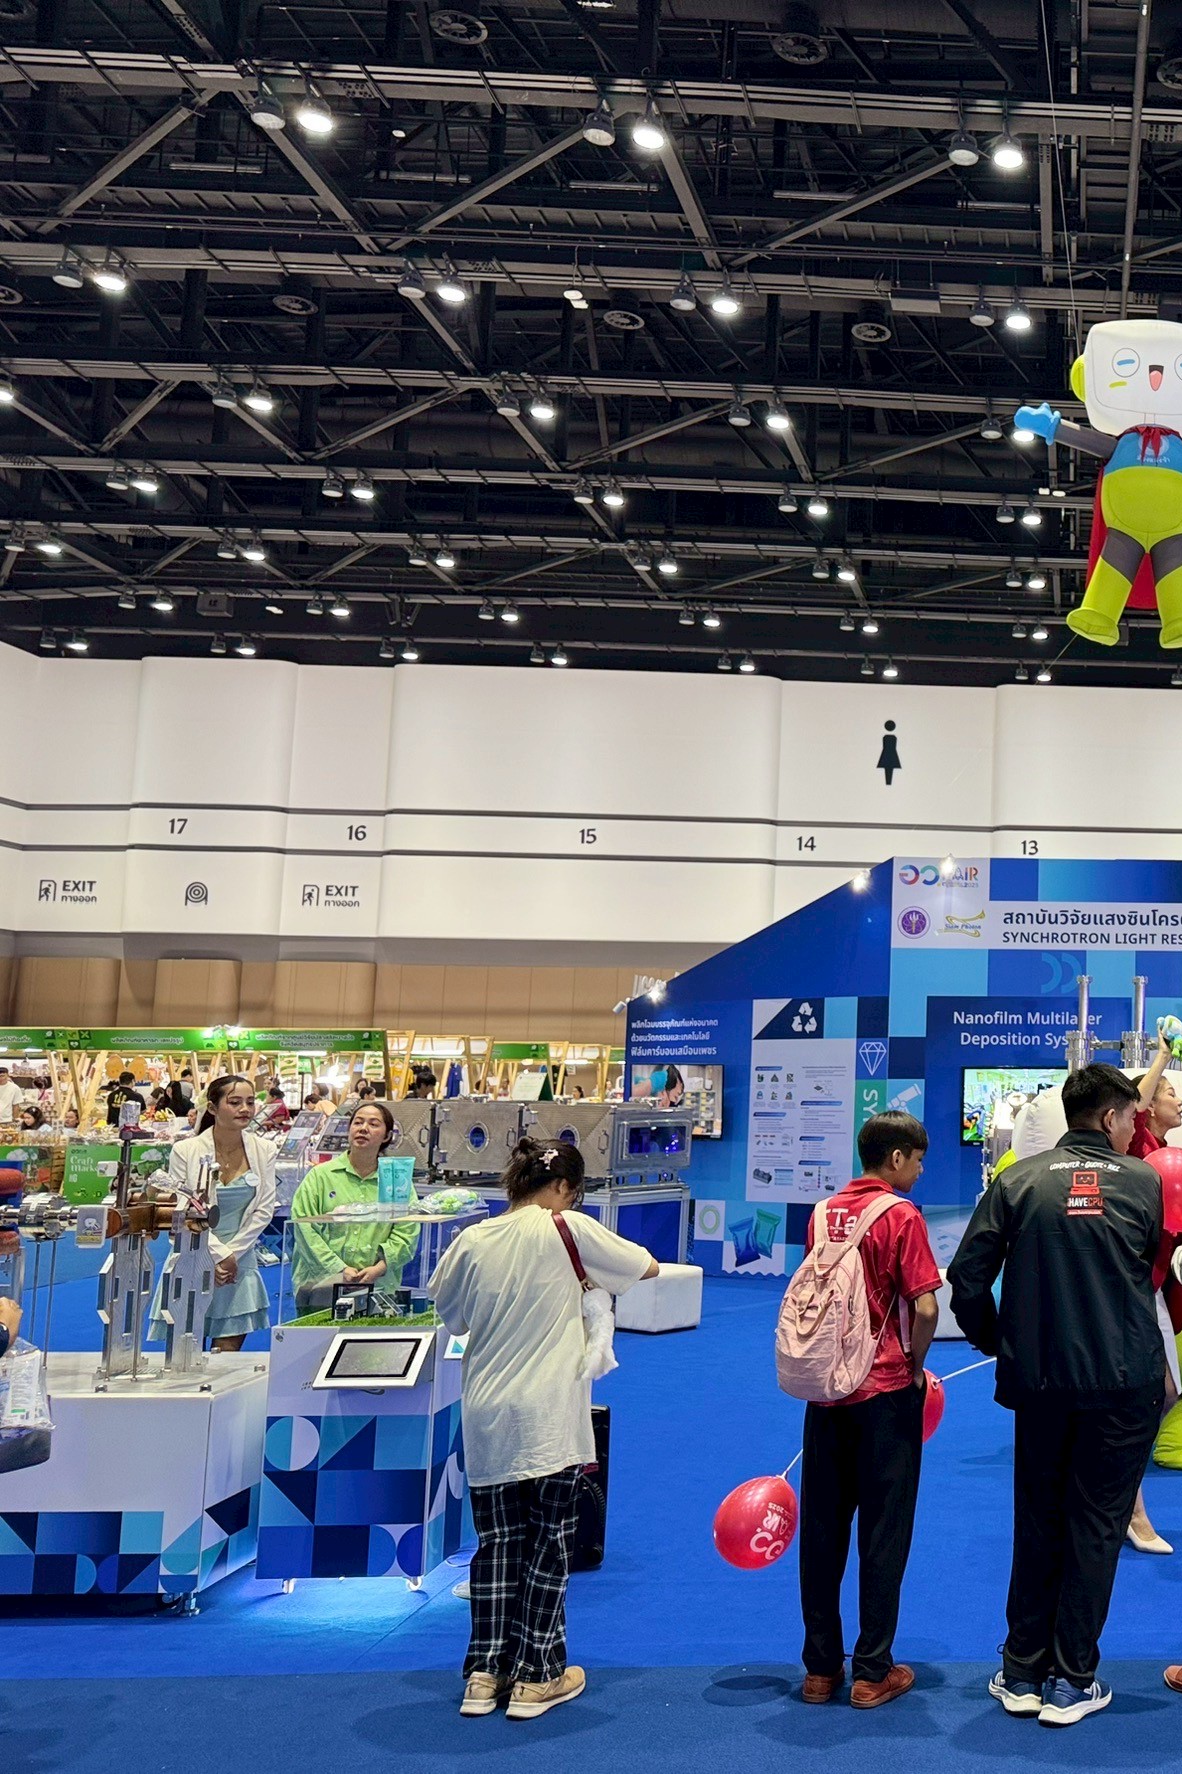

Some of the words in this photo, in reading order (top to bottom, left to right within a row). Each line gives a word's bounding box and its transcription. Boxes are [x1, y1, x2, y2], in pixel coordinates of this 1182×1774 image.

[168, 818, 188, 834] 17
[347, 825, 367, 841] 16
[578, 828, 597, 844] 15
[796, 836, 816, 851] 14
[1020, 840, 1039, 855] 13
[62, 880, 97, 892] EXIT
[325, 885, 359, 897] EXIT
[1002, 931, 1110, 945] SYNCHROTRON
[1115, 932, 1157, 945] LIGHT
[953, 1011, 1023, 1025] Nanofilm
[1027, 1011, 1103, 1025] Multilaer
[960, 1032, 1041, 1049] Deposition
[70, 1164, 98, 1173] Mark
